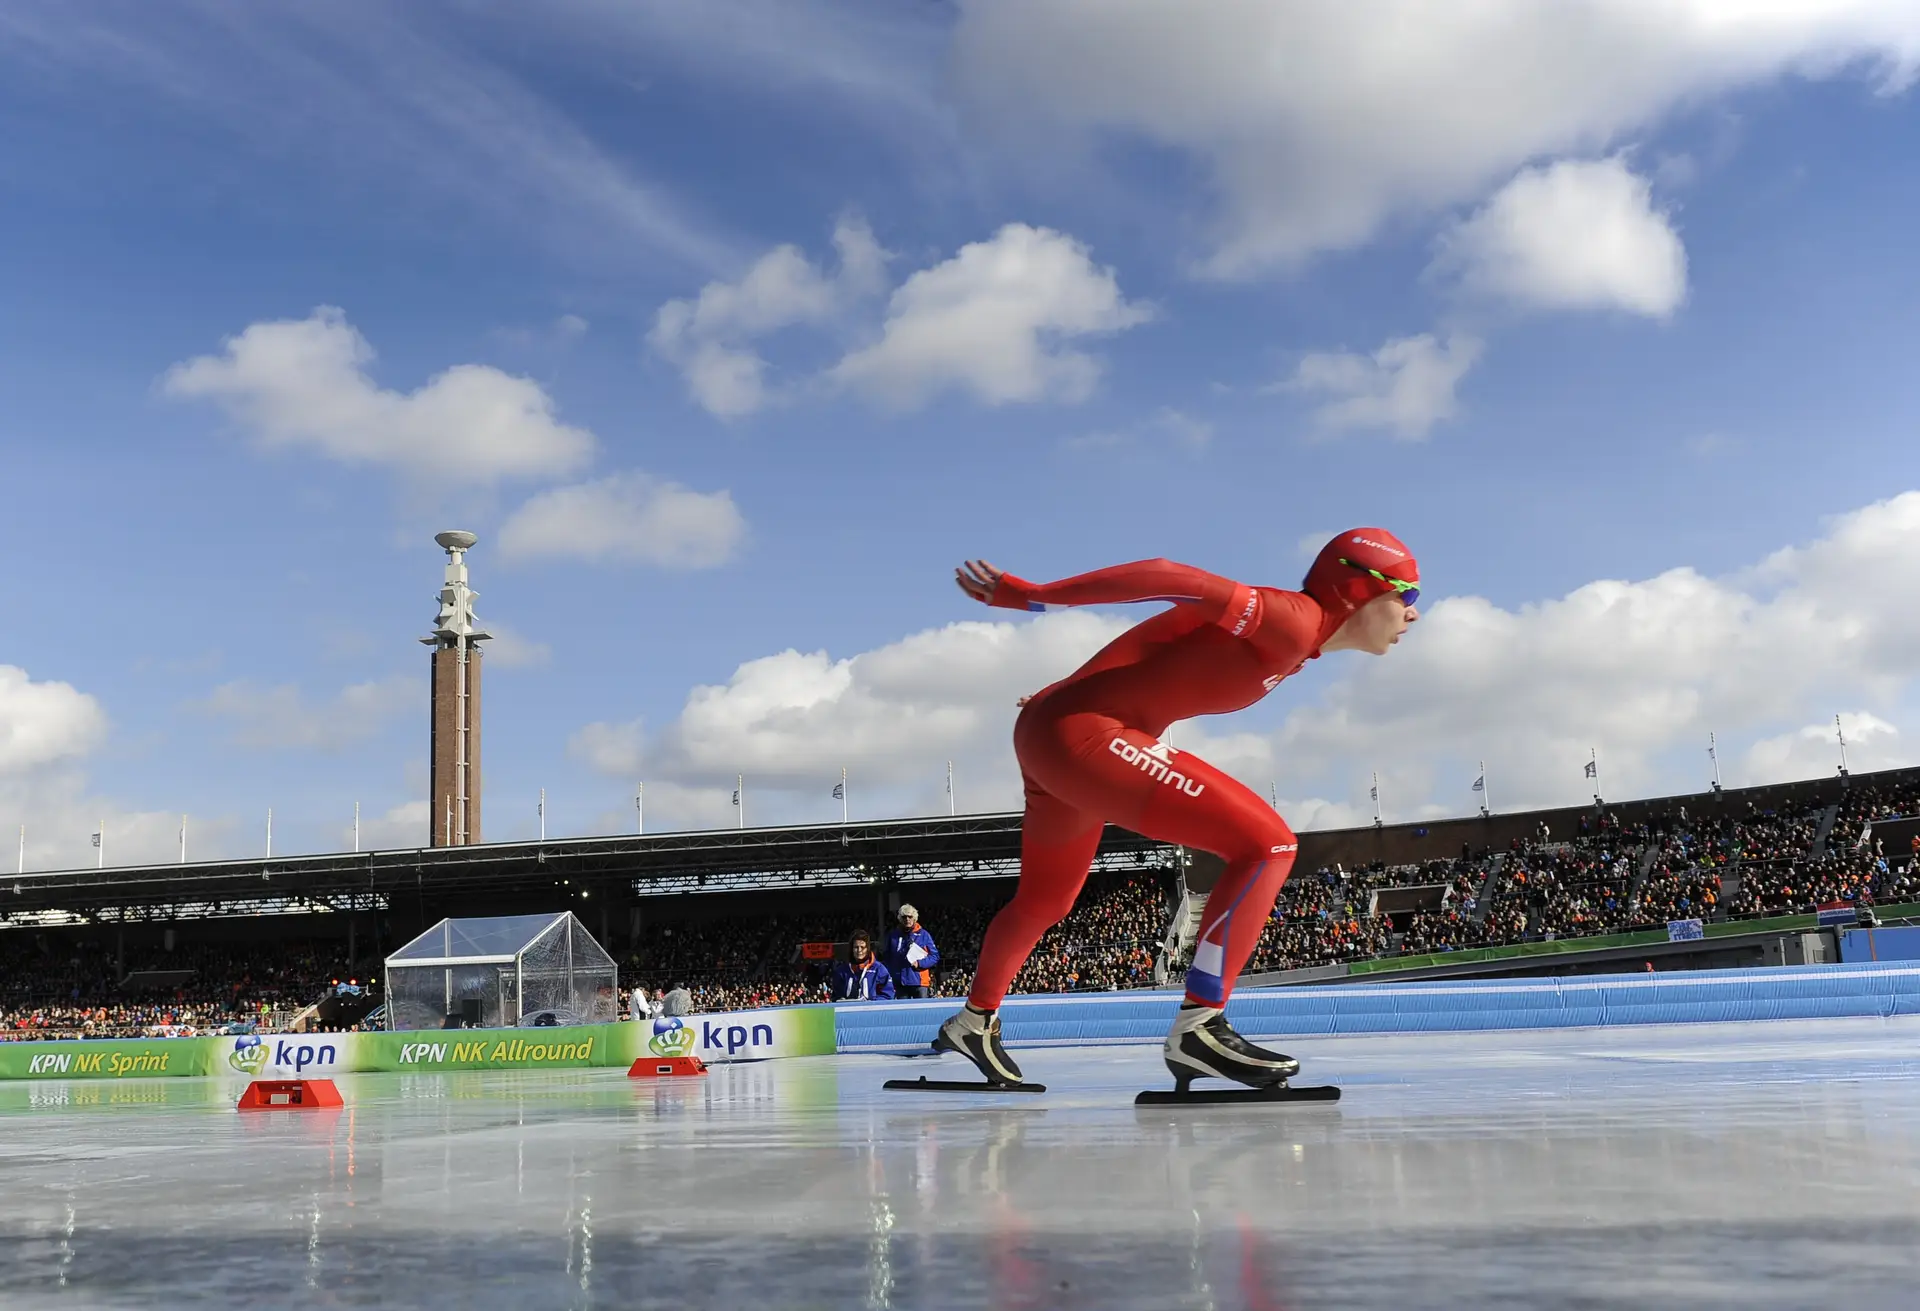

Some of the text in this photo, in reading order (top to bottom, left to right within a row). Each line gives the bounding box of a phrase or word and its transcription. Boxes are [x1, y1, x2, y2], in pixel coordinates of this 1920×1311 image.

[398, 1037, 594, 1064] KPN NK Allround
[703, 1021, 773, 1055] kpn
[28, 1050, 170, 1077] KPN NK Sprint
[275, 1040, 336, 1072] kpn
